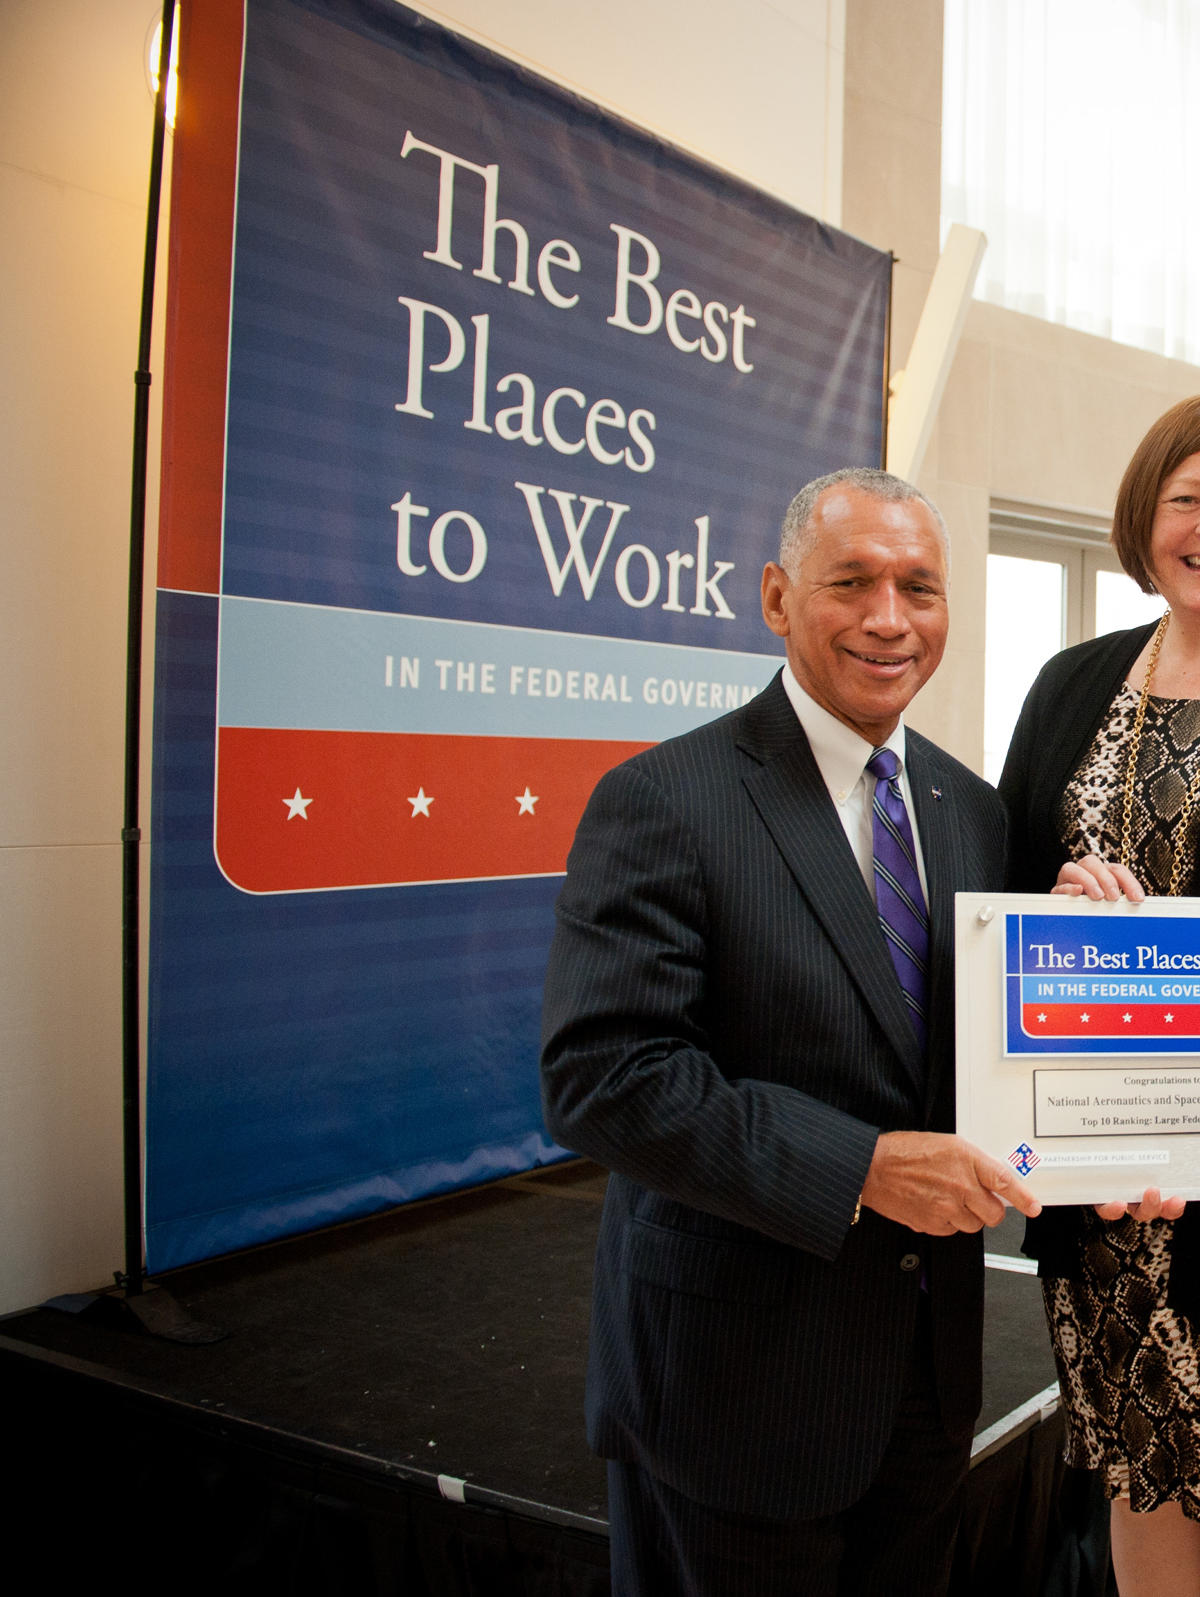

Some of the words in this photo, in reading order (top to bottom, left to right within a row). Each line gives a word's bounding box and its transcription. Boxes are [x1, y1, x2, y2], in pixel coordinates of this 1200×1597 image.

[401, 130, 581, 309] The
[606, 223, 757, 374] Best
[394, 295, 657, 473] Places
[391, 491, 488, 583] to
[514, 481, 737, 620] Work
[384, 655, 420, 689] IN
[434, 659, 497, 694] THE
[509, 666, 633, 703] FEDERAL
[643, 677, 763, 709] GOVERNM
[1029, 943, 1076, 969] The
[1081, 945, 1130, 969] Best
[1038, 983, 1055, 997] IN
[1058, 983, 1087, 997] THE
[1091, 983, 1157, 997] FEDERAL
[1123, 1076, 1192, 1086] Congratulations
[1047, 1096, 1090, 1107] National
[1093, 1094, 1152, 1106] Aeronautics
[1153, 1095, 1172, 1105] and
[1080, 1117, 1098, 1127] Top
[1100, 1117, 1111, 1126] 10
[1113, 1116, 1153, 1126] Ranking:
[1154, 1115, 1180, 1125] Large
[1043, 1155, 1092, 1163] PARTNERSHIP
[1111, 1154, 1136, 1162] PUBLIC
[1138, 1153, 1167, 1161] SERVICE
